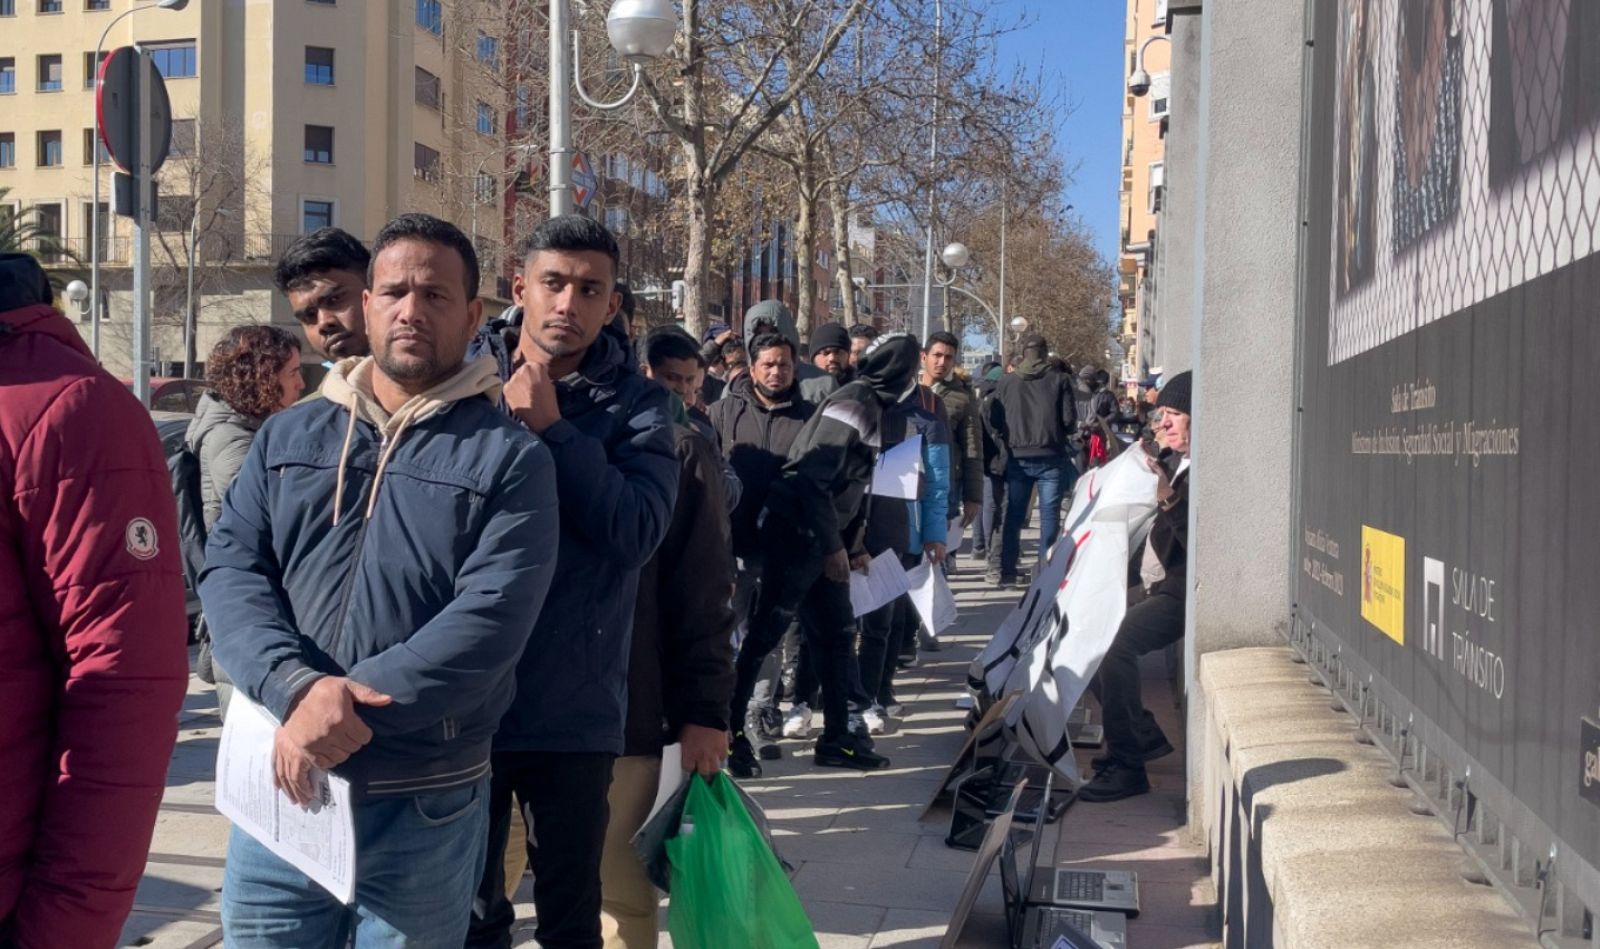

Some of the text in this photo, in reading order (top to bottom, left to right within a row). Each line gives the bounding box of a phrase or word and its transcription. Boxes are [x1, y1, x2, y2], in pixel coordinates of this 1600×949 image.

[1432, 420, 1454, 455] Social
[1454, 431, 1462, 467] y
[1463, 417, 1519, 468] Migraciones
[1452, 567, 1478, 615] SALA
[1479, 576, 1495, 623] DE
[1452, 630, 1505, 699] TRÁNSITO
